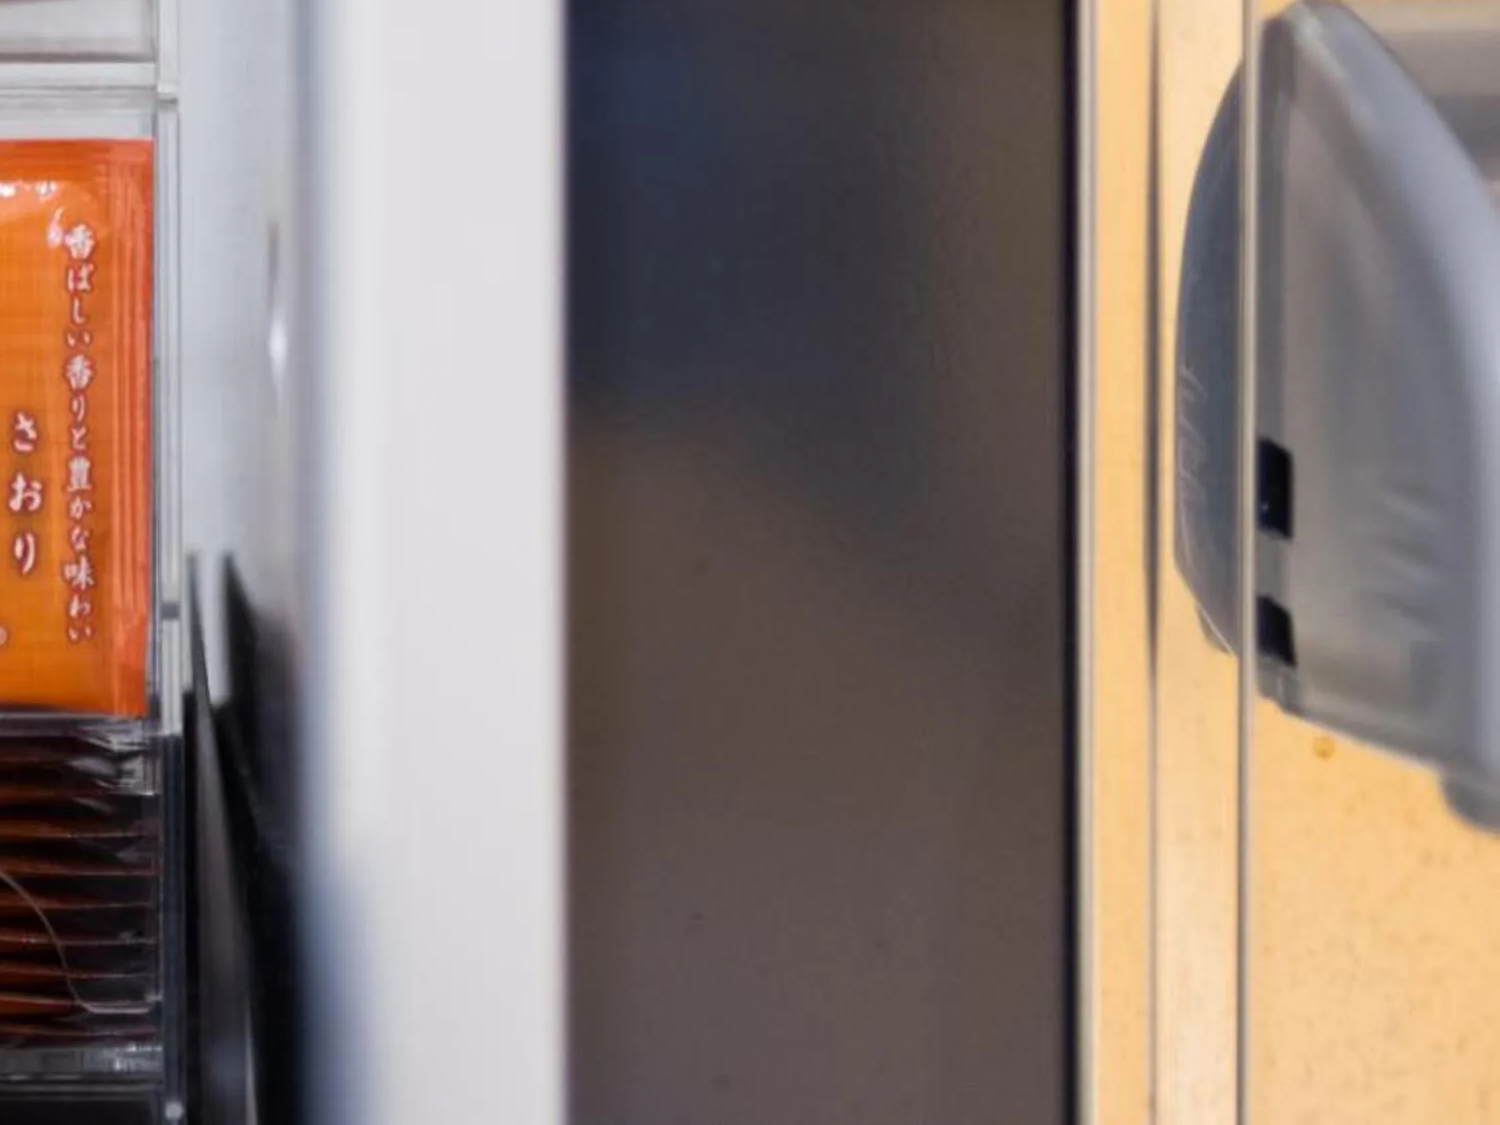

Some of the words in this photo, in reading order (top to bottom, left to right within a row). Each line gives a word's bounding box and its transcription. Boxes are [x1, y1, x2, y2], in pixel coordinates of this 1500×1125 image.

[9, 413, 43, 575] さおり
[63, 223, 95, 643] 香ばしい香りと豊かな味わい
